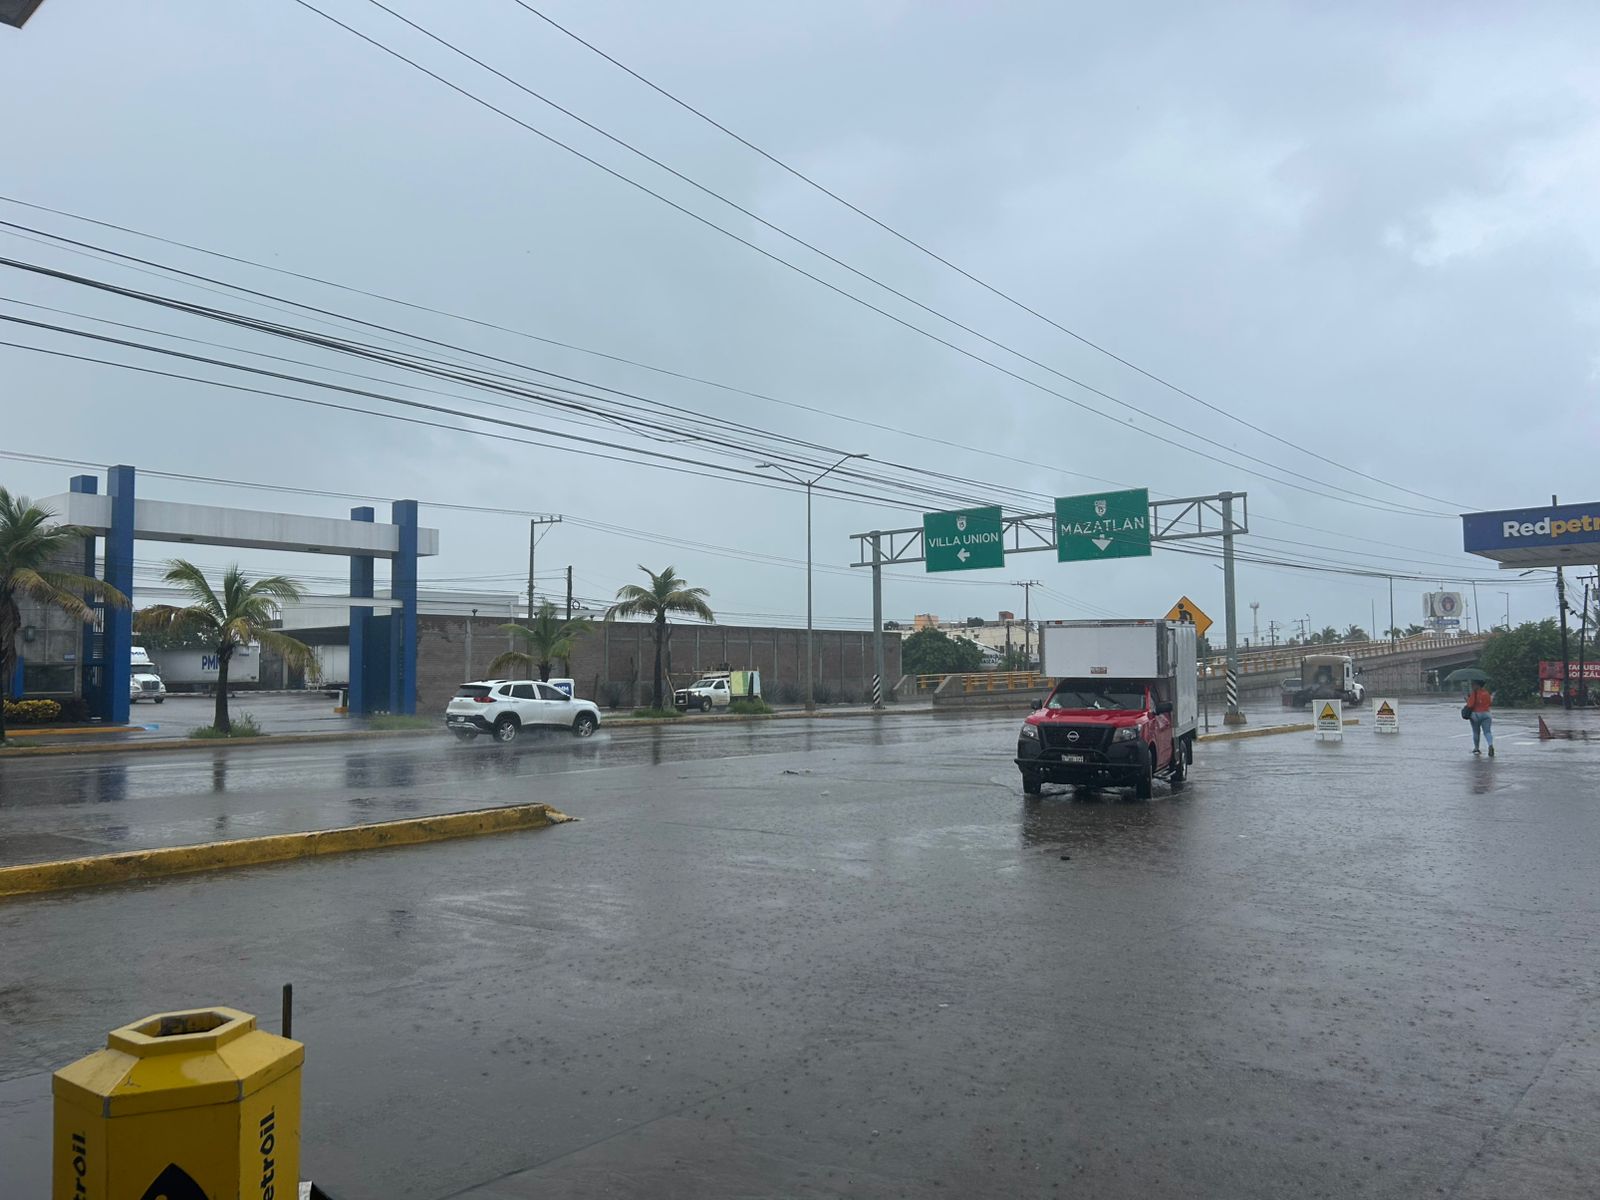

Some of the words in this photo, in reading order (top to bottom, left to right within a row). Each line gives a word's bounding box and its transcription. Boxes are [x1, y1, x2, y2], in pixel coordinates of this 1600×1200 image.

[1061, 516, 1145, 536] MAZATLAN
[928, 535, 961, 548] VILLA
[963, 532, 999, 545] UNION
